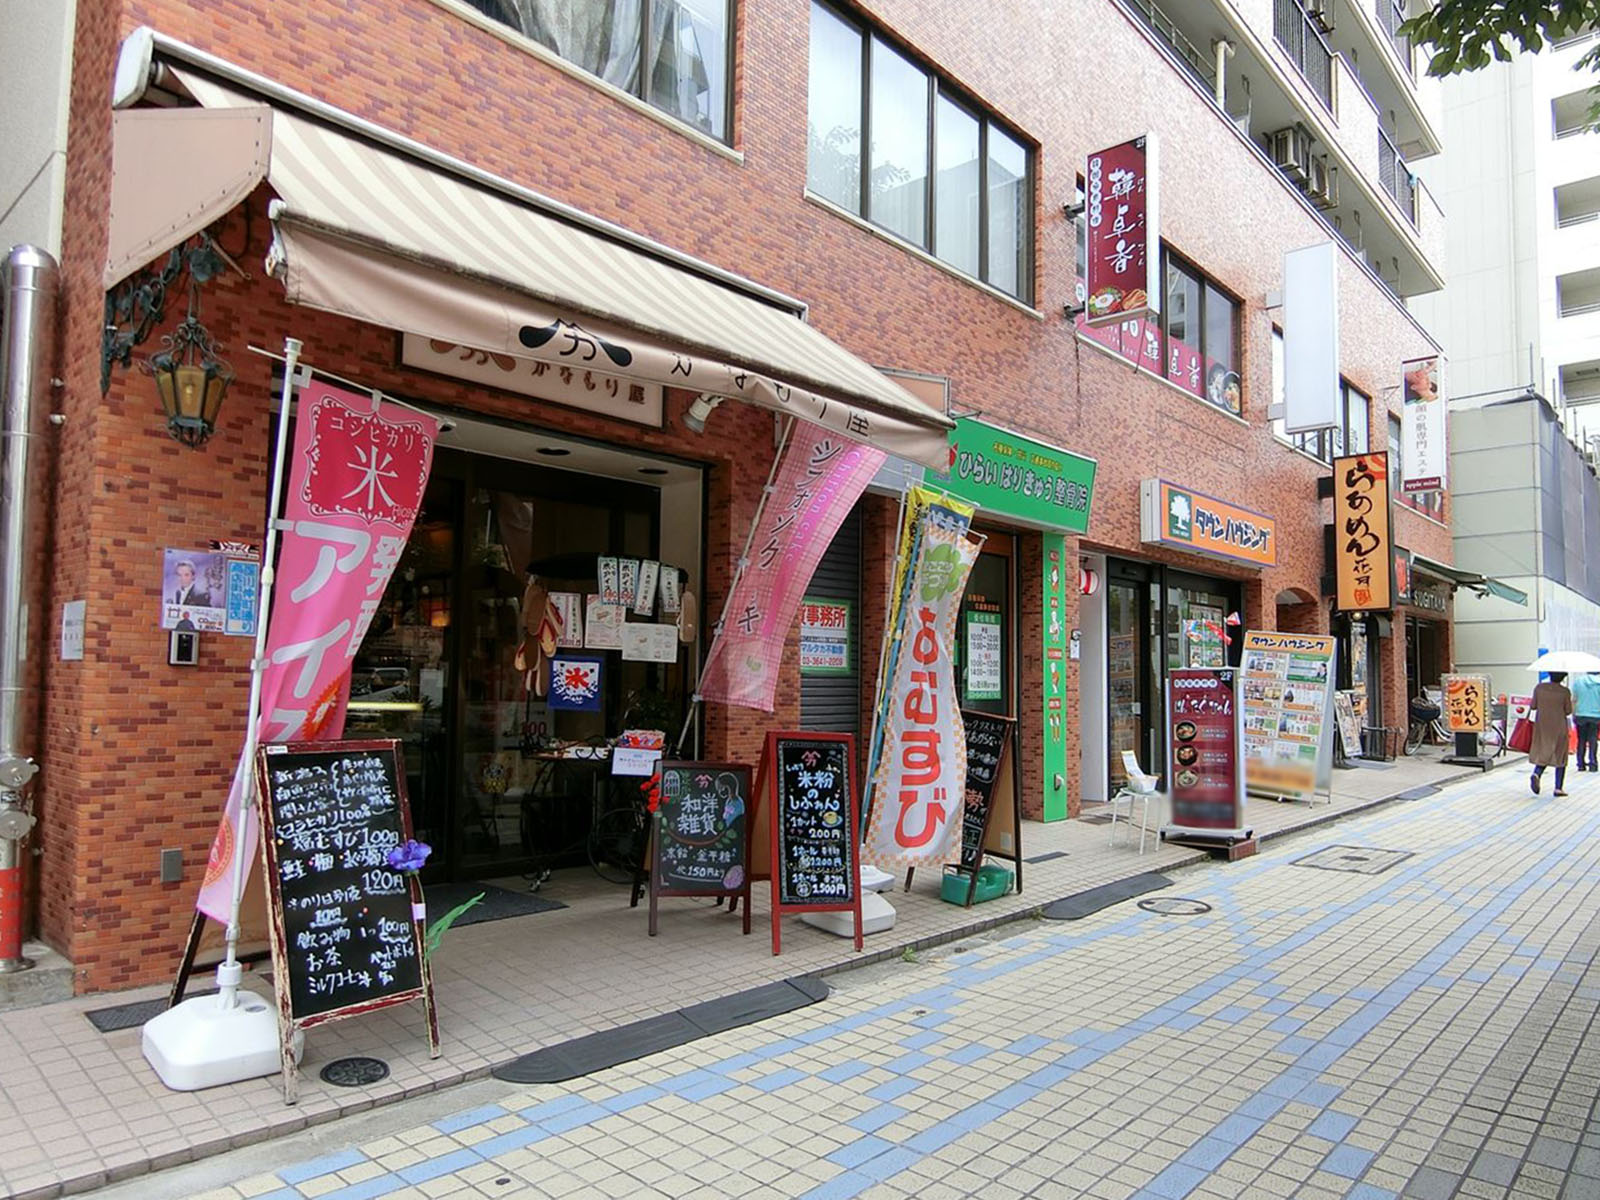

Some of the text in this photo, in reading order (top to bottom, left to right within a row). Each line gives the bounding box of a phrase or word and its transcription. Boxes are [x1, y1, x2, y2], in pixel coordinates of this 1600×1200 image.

[330, 416, 414, 453] コシヒカリ
[340, 444, 399, 511] 米
[959, 451, 998, 485] ひらい
[738, 439, 842, 632] シフォンケキ
[1195, 506, 1272, 554] タウンハウジング
[1251, 636, 1327, 651] タウンハウジング
[798, 770, 835, 789] 米粉
[680, 792, 719, 813] 和洋
[807, 789, 819, 799] の
[677, 812, 718, 836] 雑貨
[808, 828, 841, 839] 200円
